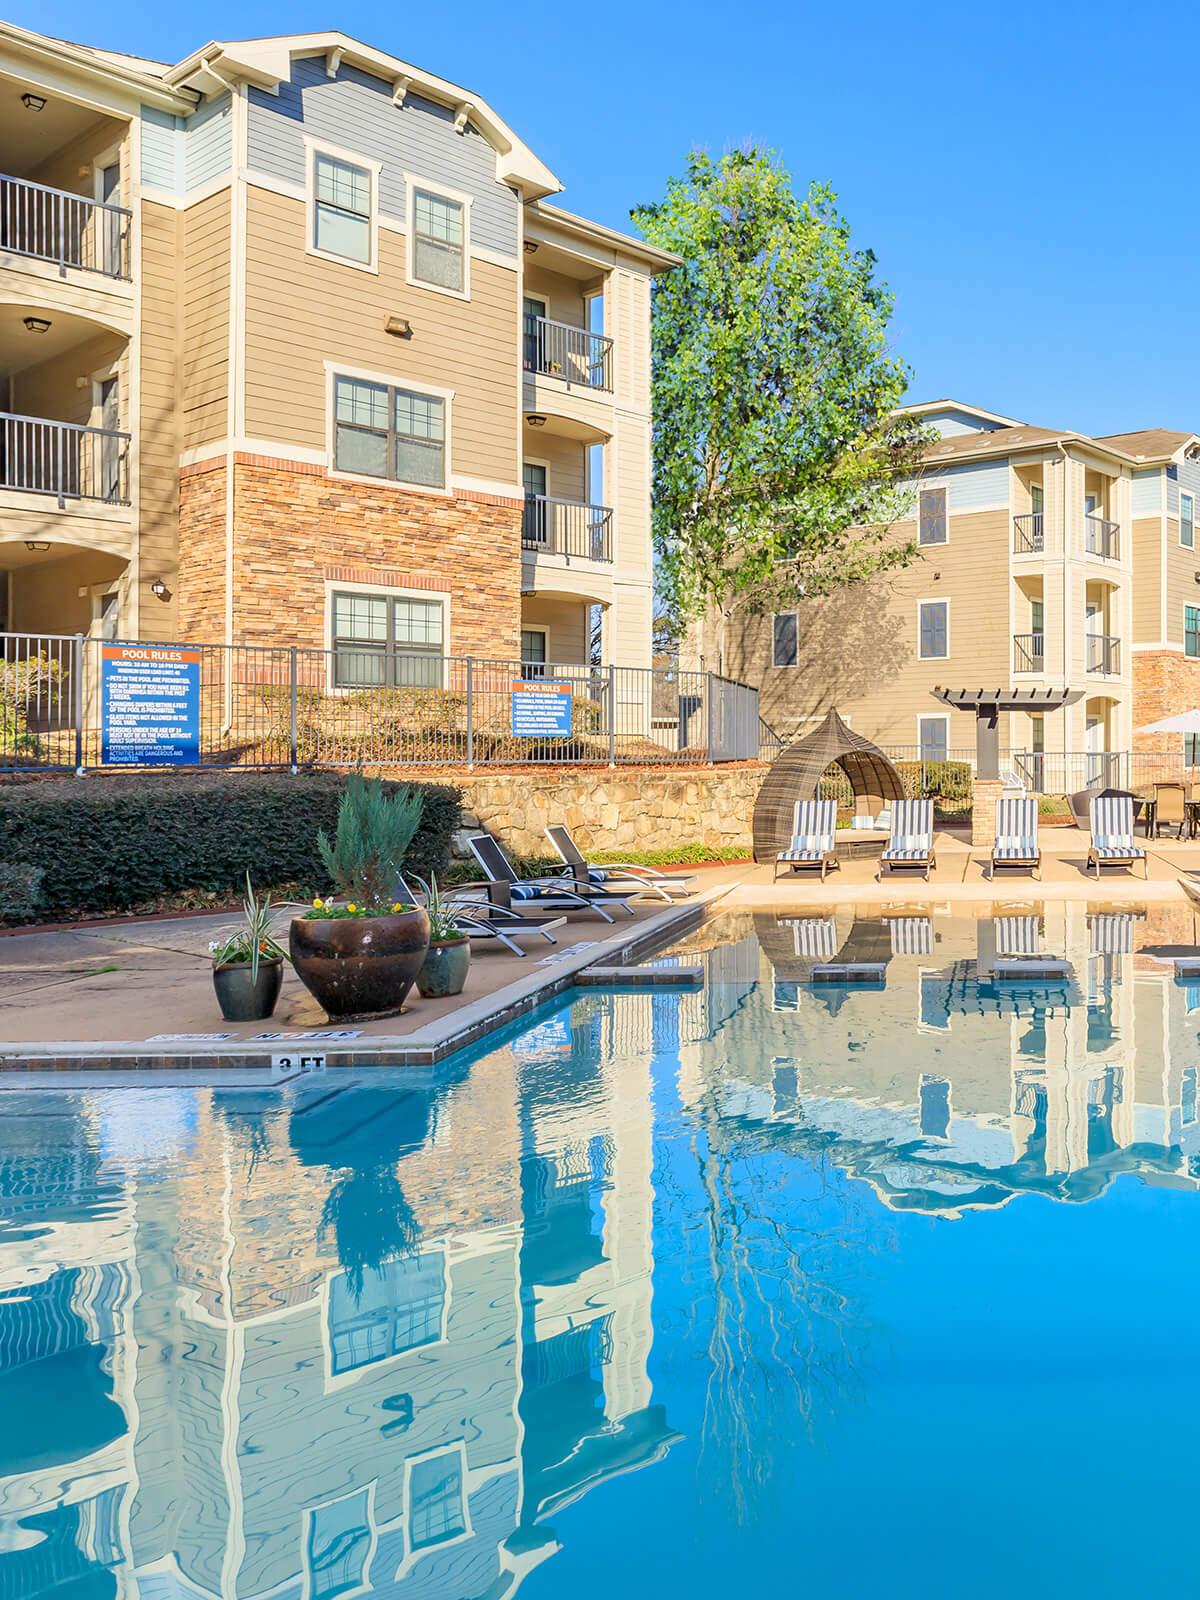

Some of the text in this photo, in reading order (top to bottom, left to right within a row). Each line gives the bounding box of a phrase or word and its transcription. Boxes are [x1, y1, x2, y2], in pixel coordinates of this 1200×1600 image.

[122, 649, 182, 661] POOL RULES
[524, 684, 560, 693] POOL RULES
[279, 1057, 324, 1068] 3 FT
